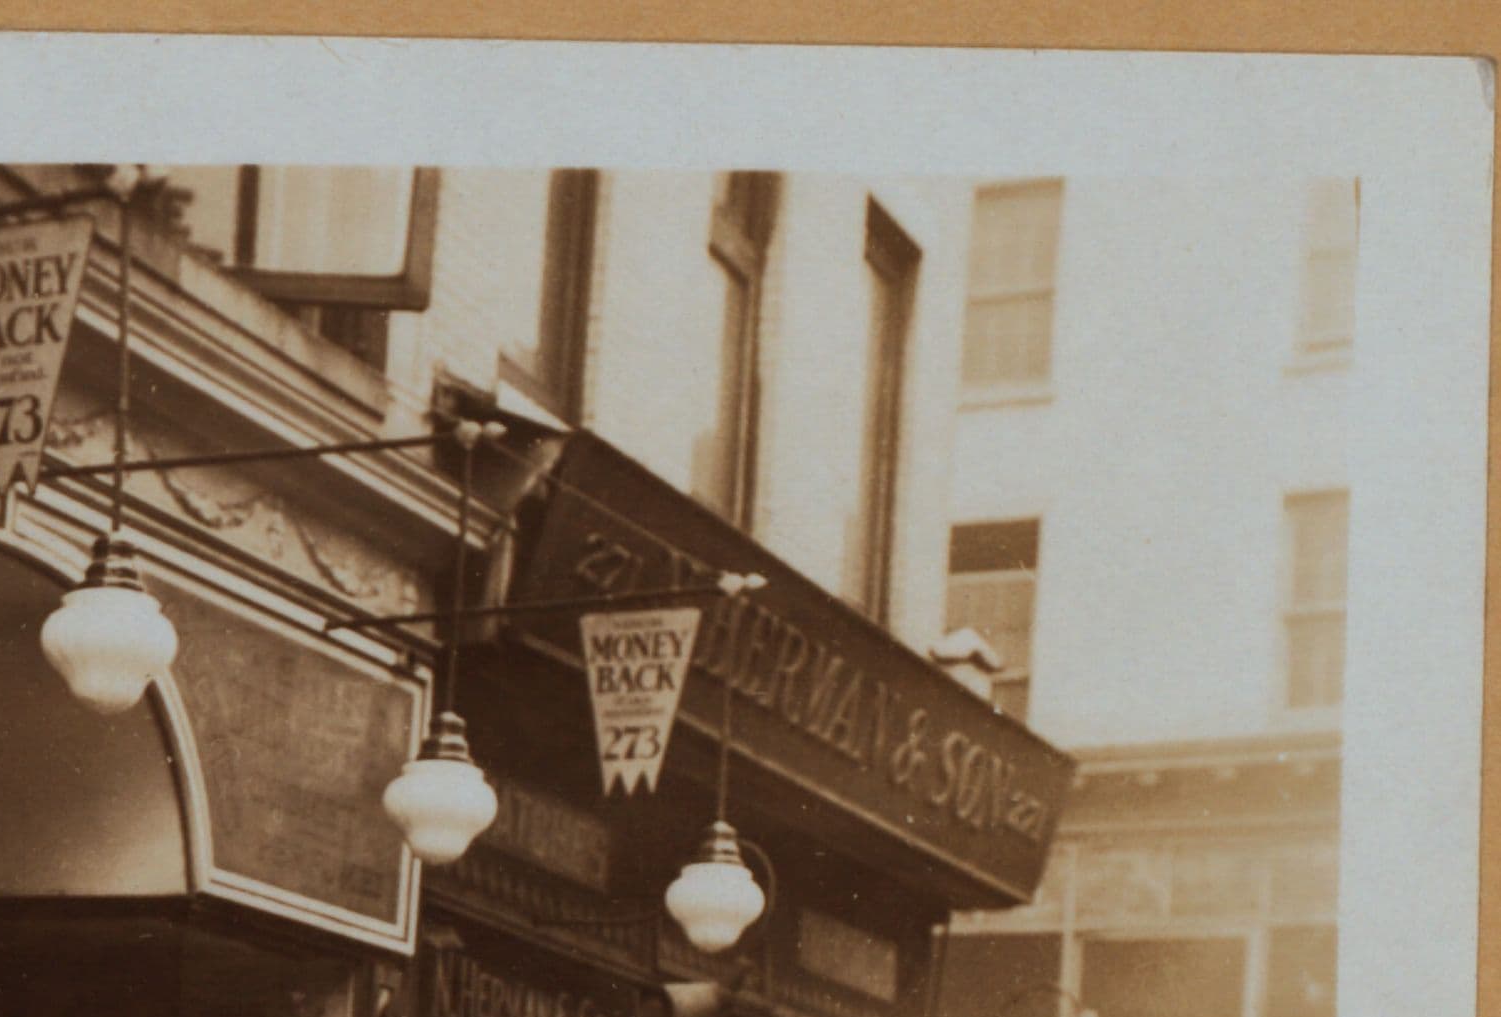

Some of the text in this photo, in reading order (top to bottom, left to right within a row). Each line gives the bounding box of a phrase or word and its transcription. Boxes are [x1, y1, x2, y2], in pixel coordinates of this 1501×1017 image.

[590, 629, 686, 664] MONEY
[596, 663, 675, 694] BACK
[603, 726, 661, 762] 273
[892, 707, 928, 786] &
